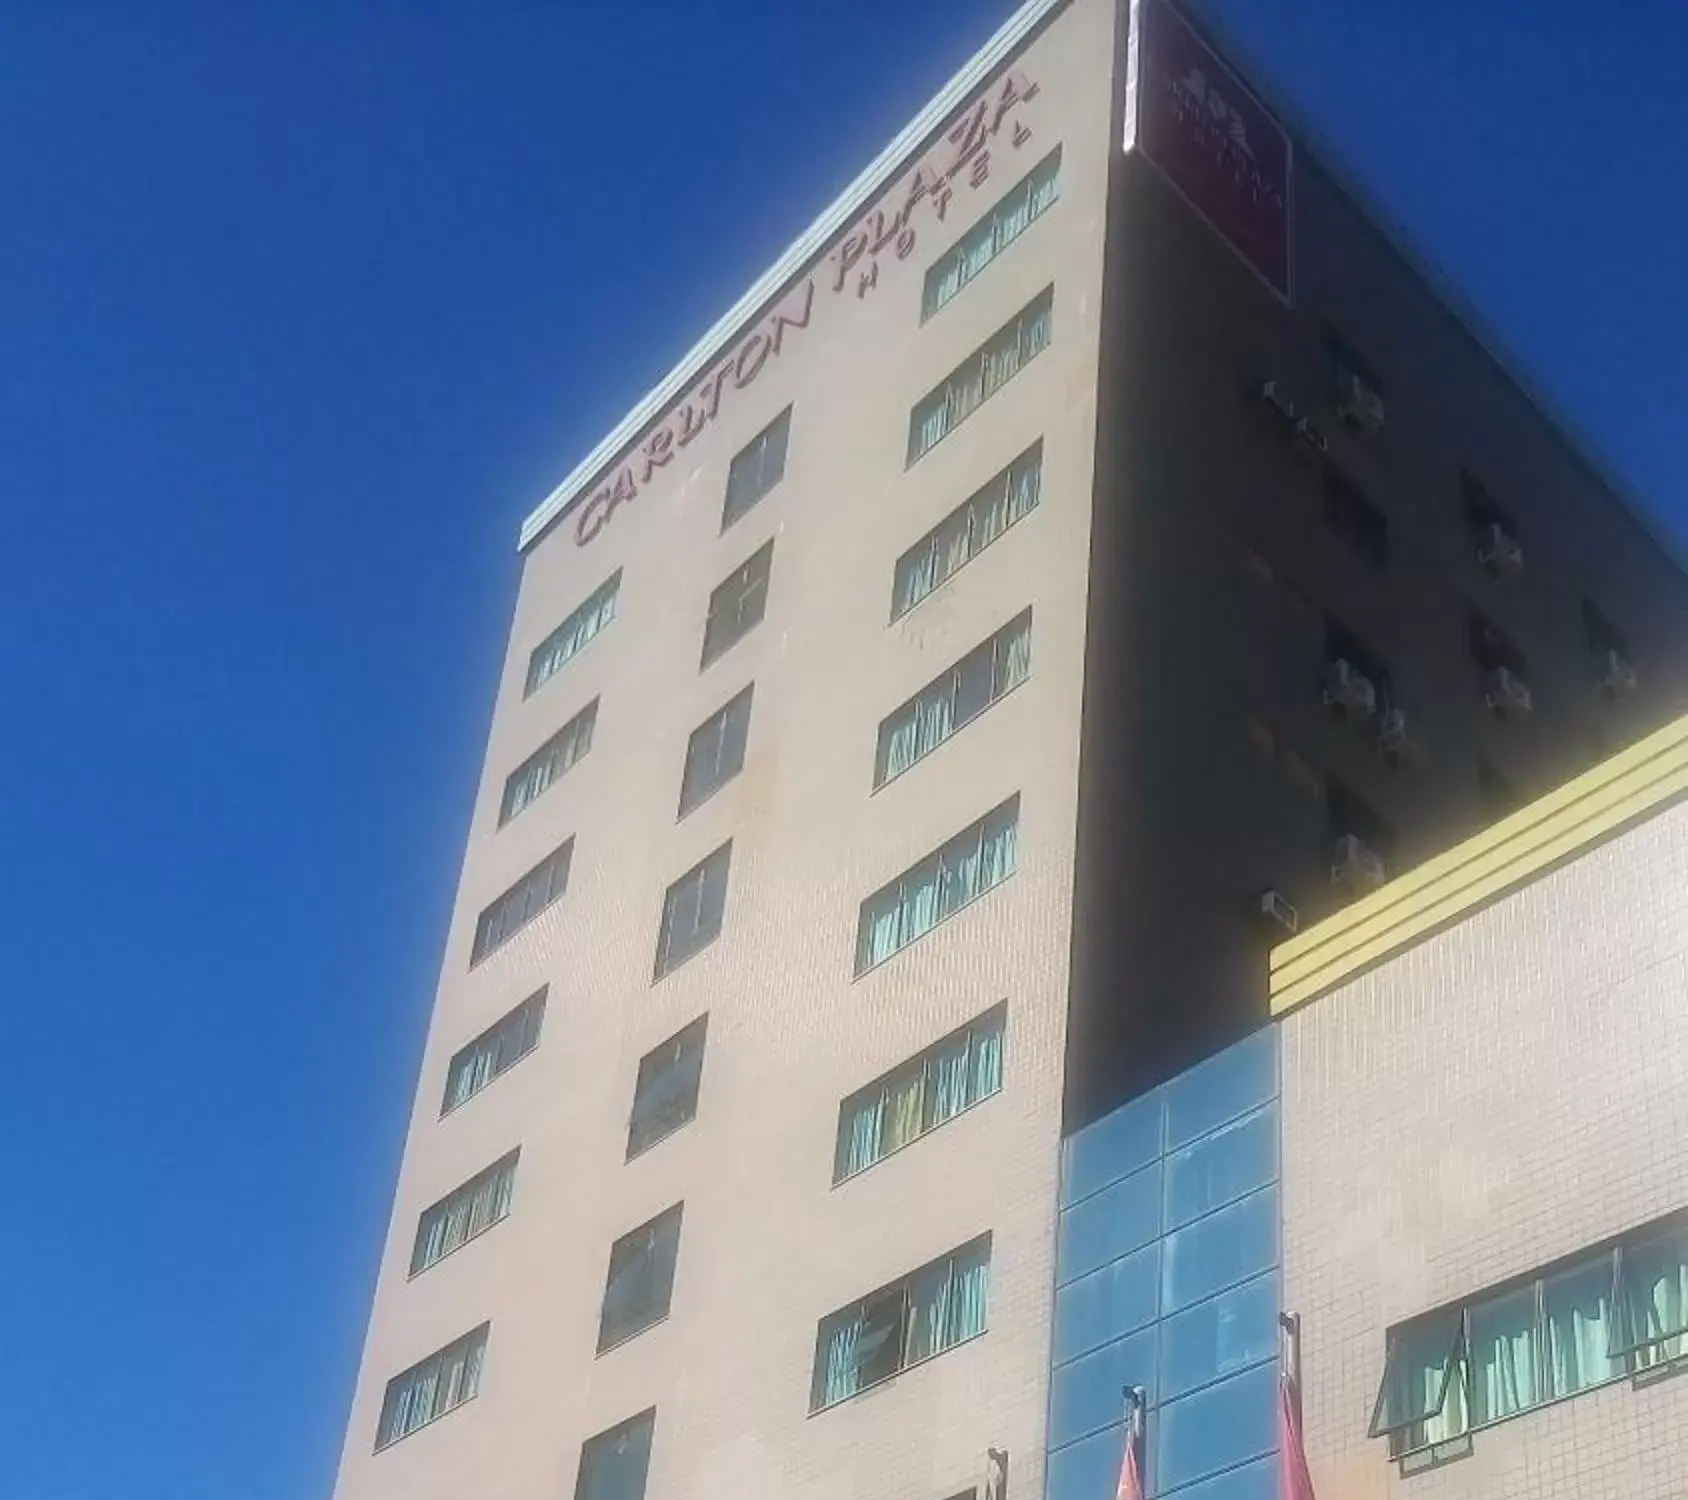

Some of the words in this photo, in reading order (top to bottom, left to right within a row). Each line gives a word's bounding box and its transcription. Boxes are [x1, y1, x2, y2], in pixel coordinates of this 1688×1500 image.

[575, 281, 814, 547] CARLTON
[831, 70, 1041, 293] PLAZA
[856, 119, 1033, 299] HOTEL
